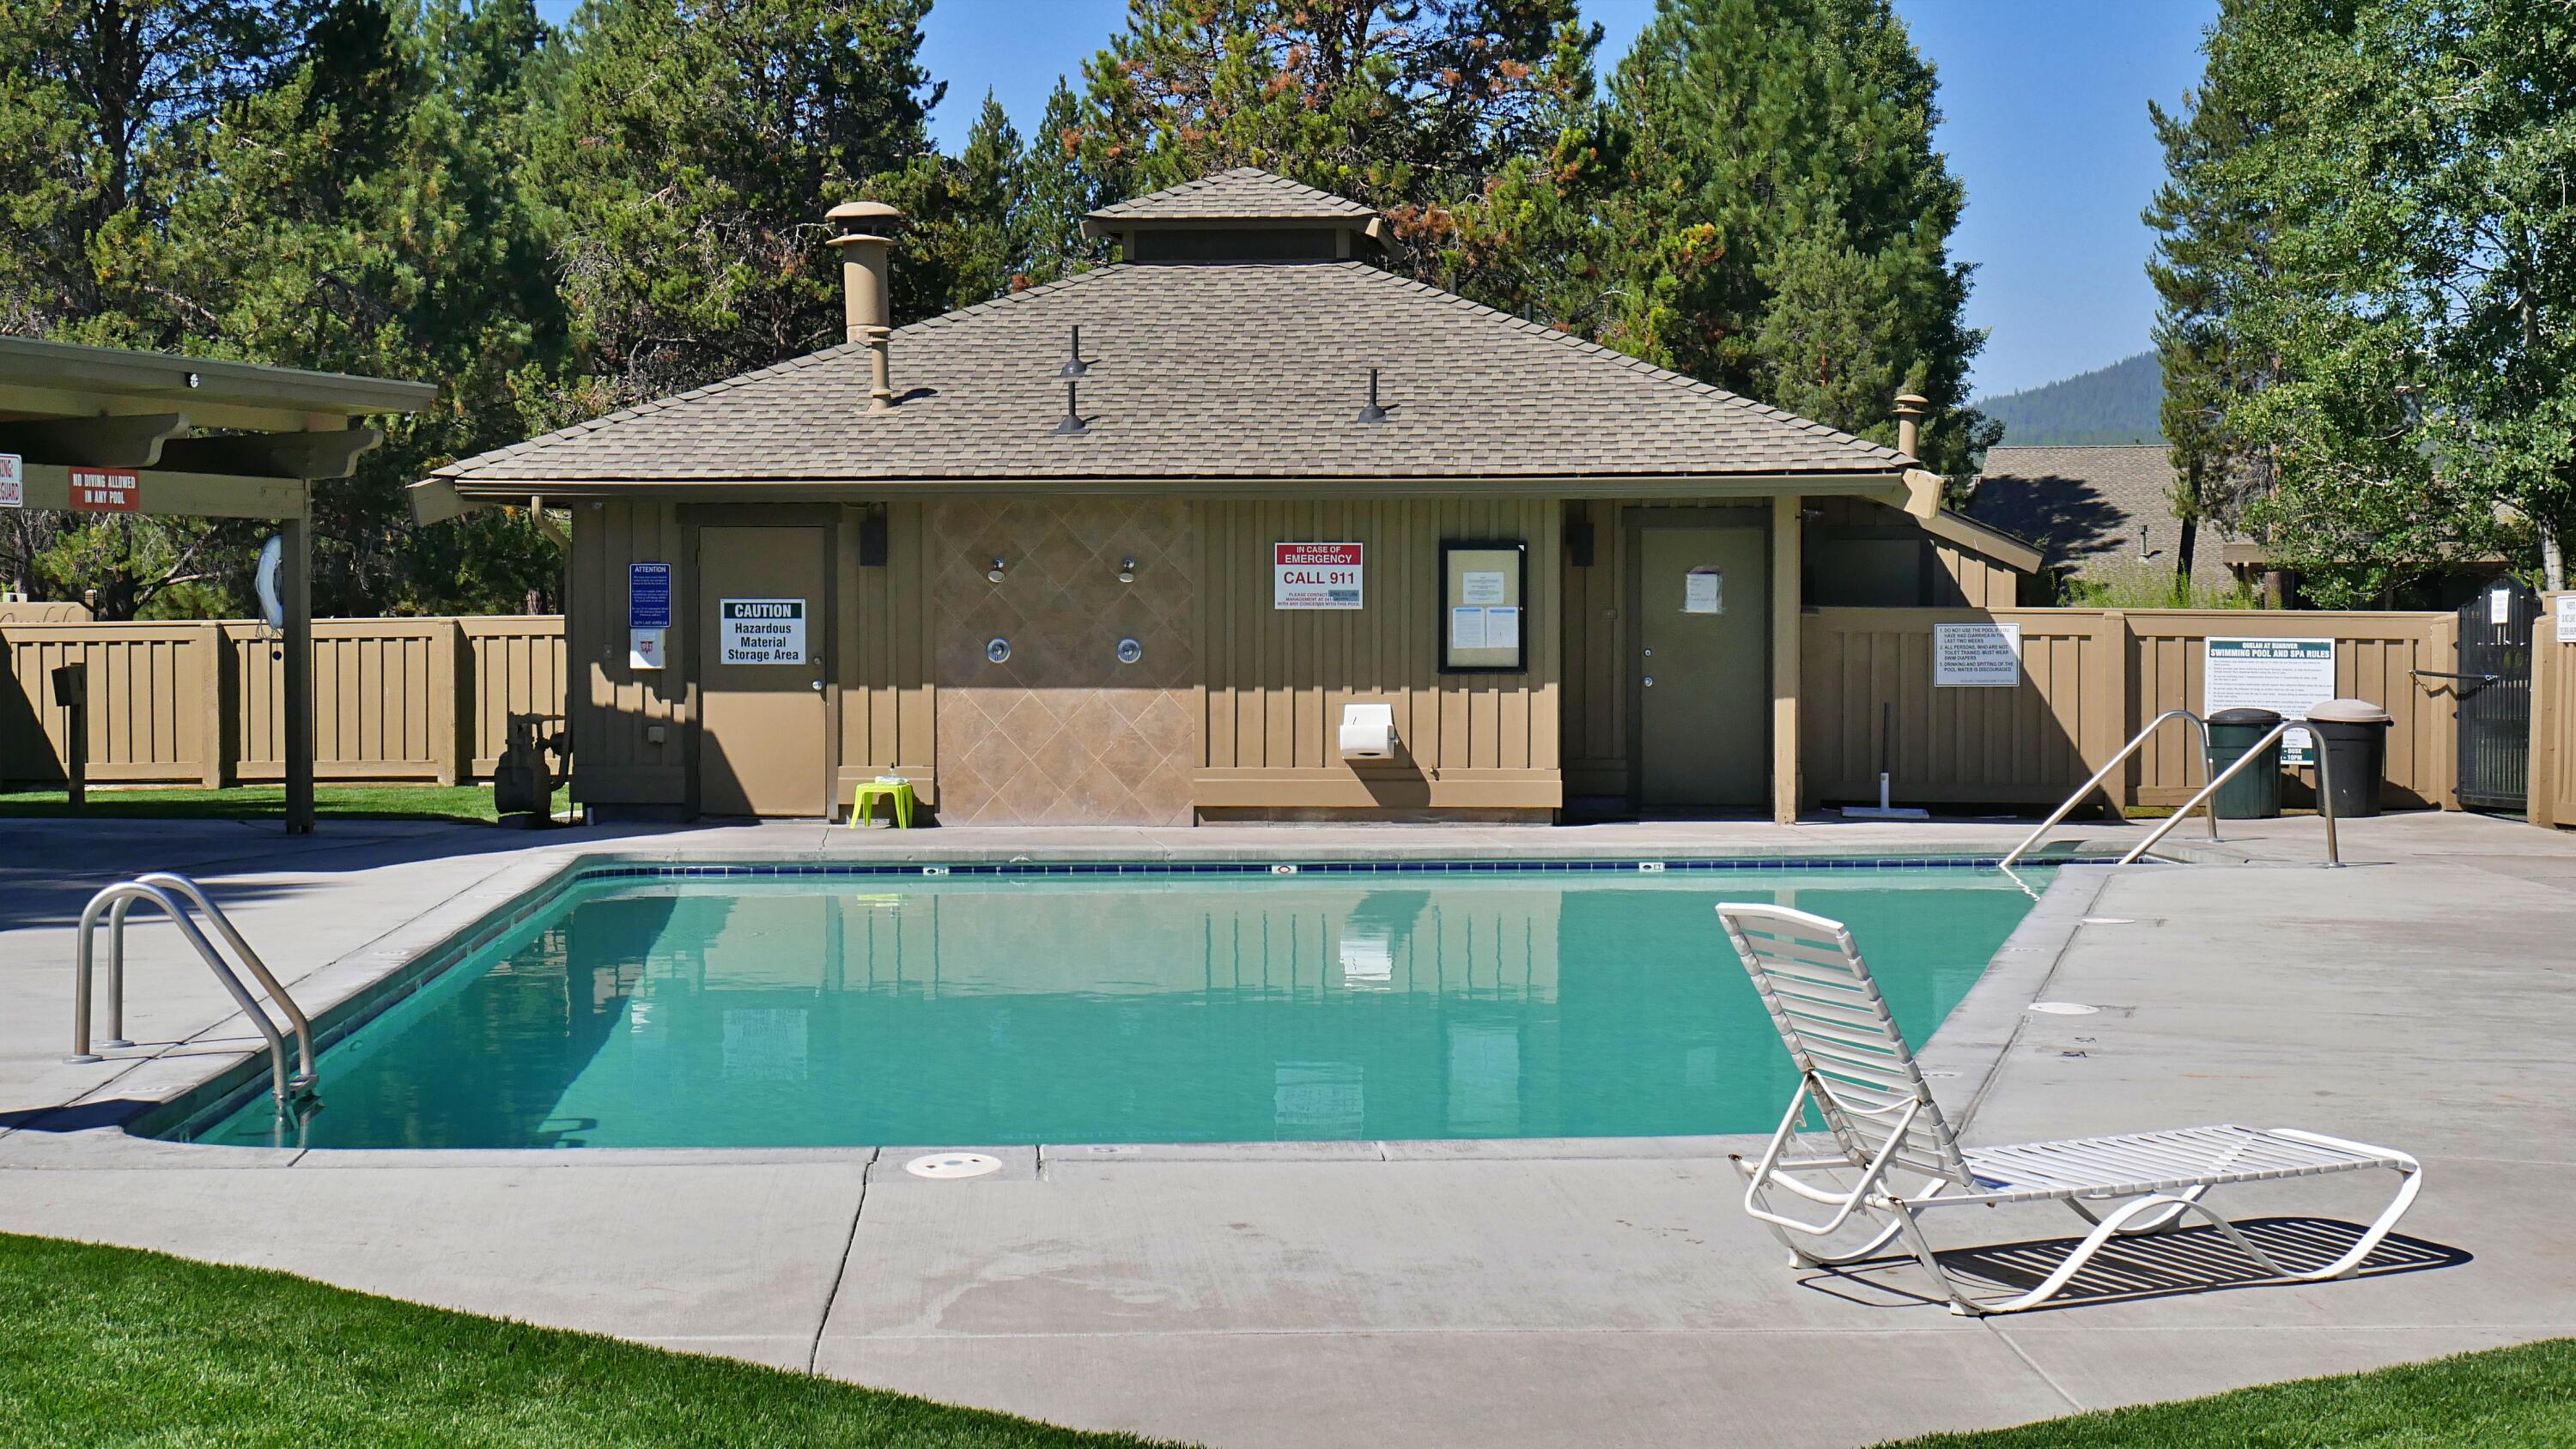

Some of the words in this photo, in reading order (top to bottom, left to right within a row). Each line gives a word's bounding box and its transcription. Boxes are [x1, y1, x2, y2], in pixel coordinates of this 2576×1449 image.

[0, 458, 14, 478] ING:
[73, 473, 82, 487] NO
[85, 474, 106, 488] DIVING
[108, 475, 136, 489] ALLOWED
[85, 490, 92, 503] IN
[94, 490, 107, 504] ANY
[109, 491, 125, 504] POOL
[1285, 554, 1352, 564] EMERGENCY
[1284, 572, 1325, 584] CALL
[1330, 572, 1354, 584] 911
[735, 603, 792, 618] CAUTION
[735, 622, 792, 634] Hazardous
[741, 637, 786, 647] Material
[728, 649, 769, 662] Storage
[774, 649, 799, 660] Area
[2210, 649, 2251, 658] SWIMMING
[2252, 649, 2271, 658] POOL
[2274, 649, 2288, 658] AND
[2306, 650, 2330, 658] RULES
